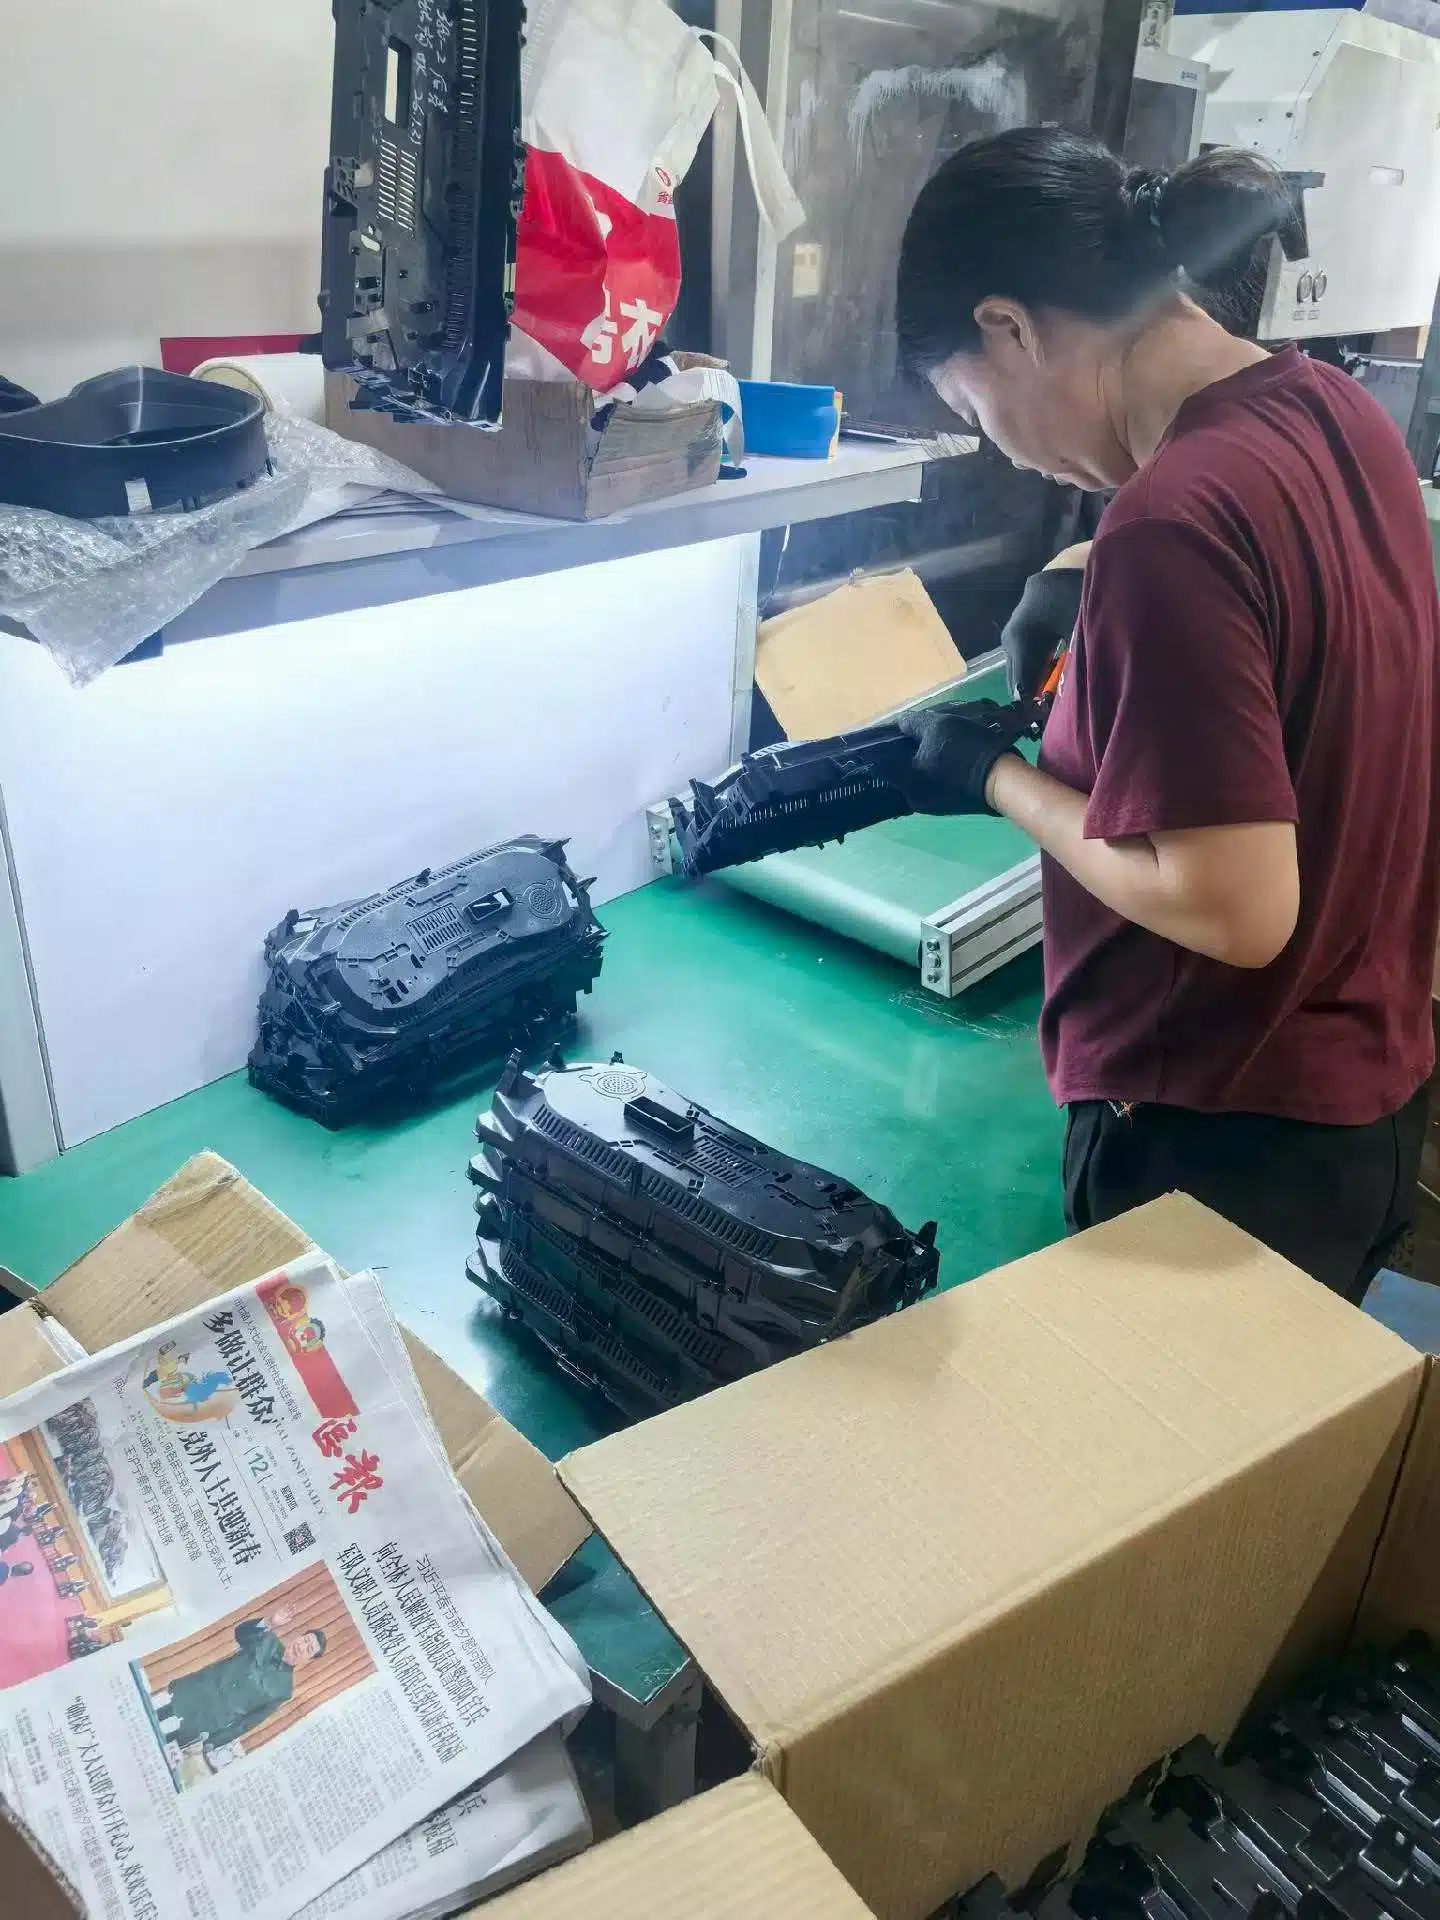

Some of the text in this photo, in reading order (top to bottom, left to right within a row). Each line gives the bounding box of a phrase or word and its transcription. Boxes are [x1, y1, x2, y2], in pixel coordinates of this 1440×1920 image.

[203, 1311, 284, 1425] 多做让群众
[176, 1431, 262, 1565] 党外人士共迎新春
[248, 1451, 269, 1478] 12
[416, 1553, 496, 1686] 习近平春节前夕慰问部队
[423, 1813, 458, 1857] 祝福
